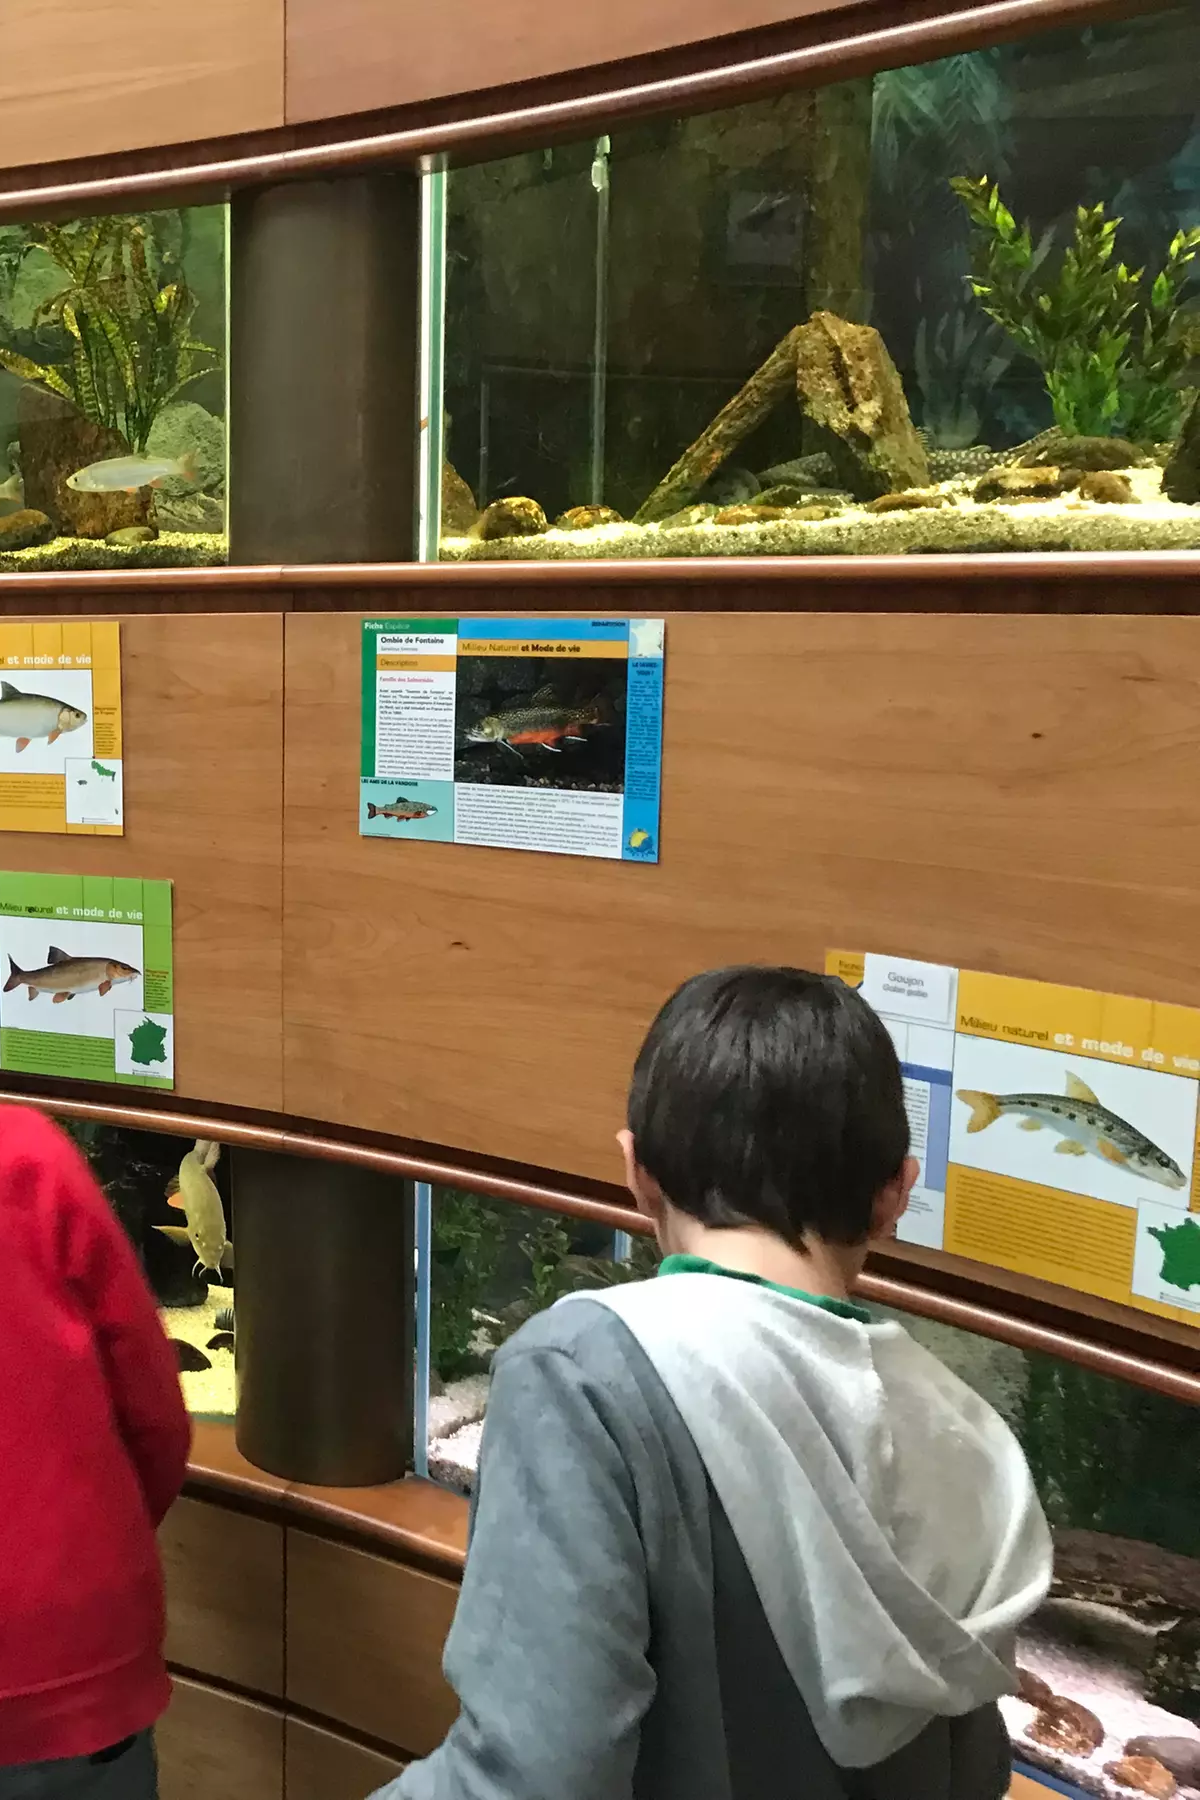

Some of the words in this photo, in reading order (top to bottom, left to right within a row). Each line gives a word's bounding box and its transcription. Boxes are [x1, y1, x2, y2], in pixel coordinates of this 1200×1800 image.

[404, 636, 413, 644] de
[415, 636, 444, 644] Fontaine
[462, 643, 487, 652] Milieu
[488, 643, 519, 652] Naturel
[521, 644, 530, 652] et
[531, 644, 554, 652] Mode
[556, 644, 566, 653] de
[568, 644, 580, 653] vie
[7, 655, 20, 665] et
[23, 655, 54, 665] mode
[58, 654, 72, 664] de
[75, 653, 91, 664] vie
[0, 902, 23, 913] Milieu
[24, 903, 54, 914] naturel
[56, 905, 69, 915] et
[73, 906, 104, 917] mode
[108, 908, 123, 918] de
[126, 909, 143, 920] vie
[887, 971, 924, 988] Goujon
[960, 1014, 998, 1031] Milieu
[1002, 1025, 1049, 1041] naturel
[1054, 1032, 1075, 1046] et
[1081, 1038, 1134, 1058] mode
[1141, 1047, 1165, 1064] de
[1172, 1054, 1200, 1071] vie
